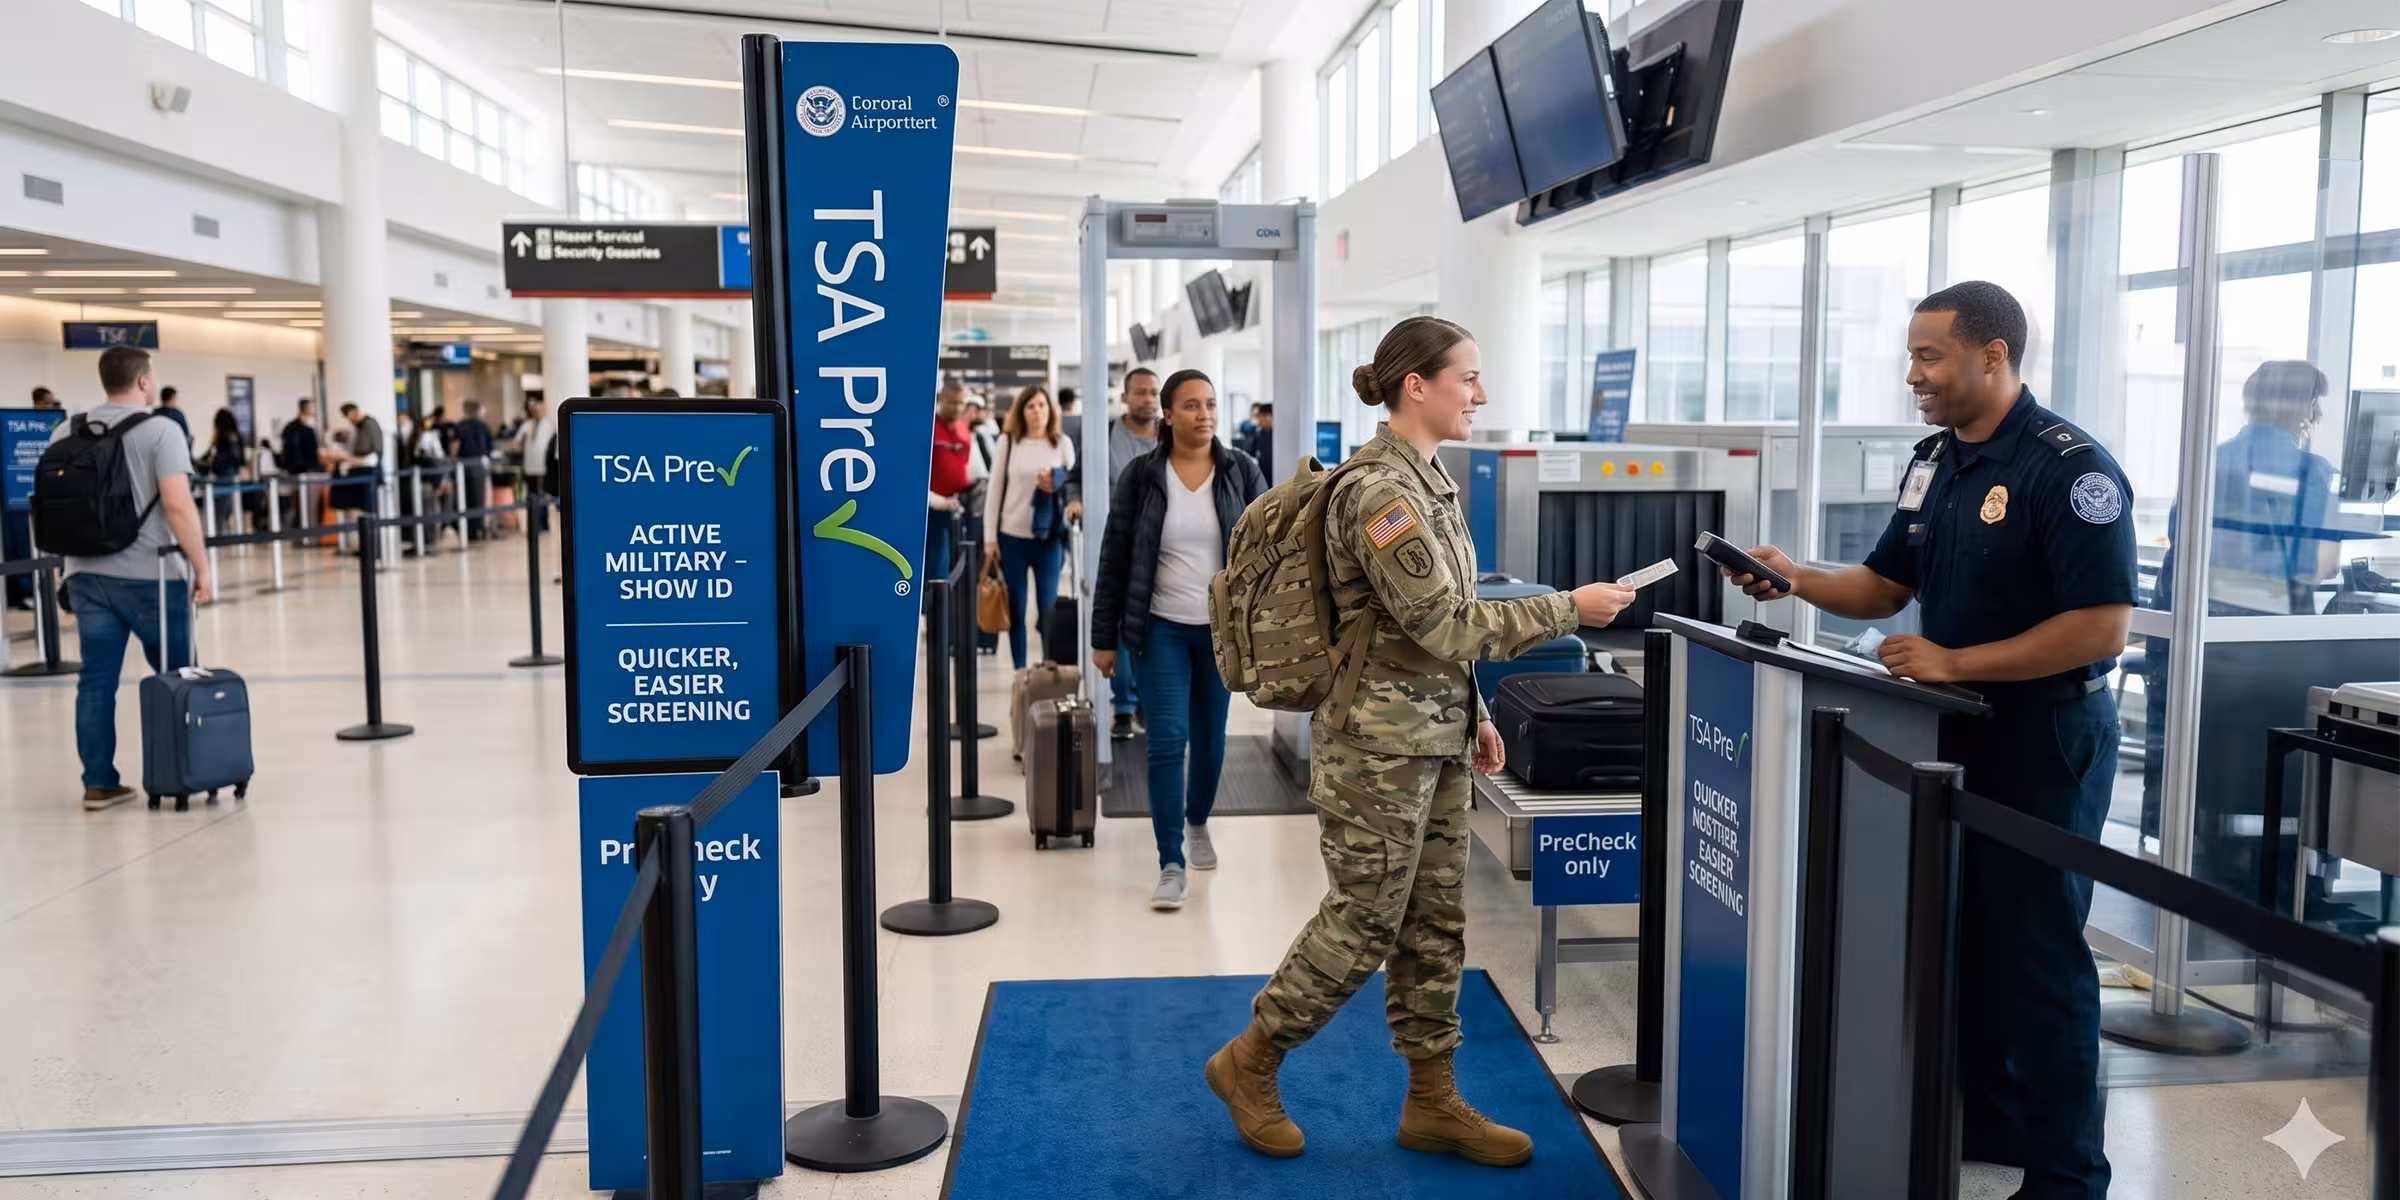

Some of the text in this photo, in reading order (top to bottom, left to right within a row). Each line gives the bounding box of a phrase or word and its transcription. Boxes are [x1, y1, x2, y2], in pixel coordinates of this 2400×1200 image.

[851, 115, 938, 132] Airporttert
[554, 245, 604, 261] Security
[814, 190, 885, 342] TSA
[819, 367, 887, 492] Pre
[594, 455, 715, 483] TSA Pre
[629, 524, 722, 545] ACTIVE
[605, 551, 728, 573] MILITARY
[620, 578, 733, 600] SHOW ID
[618, 647, 738, 672] QUICKER,
[634, 674, 725, 696] EASIER
[607, 700, 751, 724] SCREENING
[1689, 713, 1734, 762] TSA Pre
[1693, 780, 1740, 829] QUICKER,
[600, 833, 761, 865] Preck
[1539, 832, 1637, 852] PreCheck
[1564, 856, 1611, 878] only
[1699, 838, 1734, 881] EASIER
[1689, 859, 1743, 917] SCREENING
